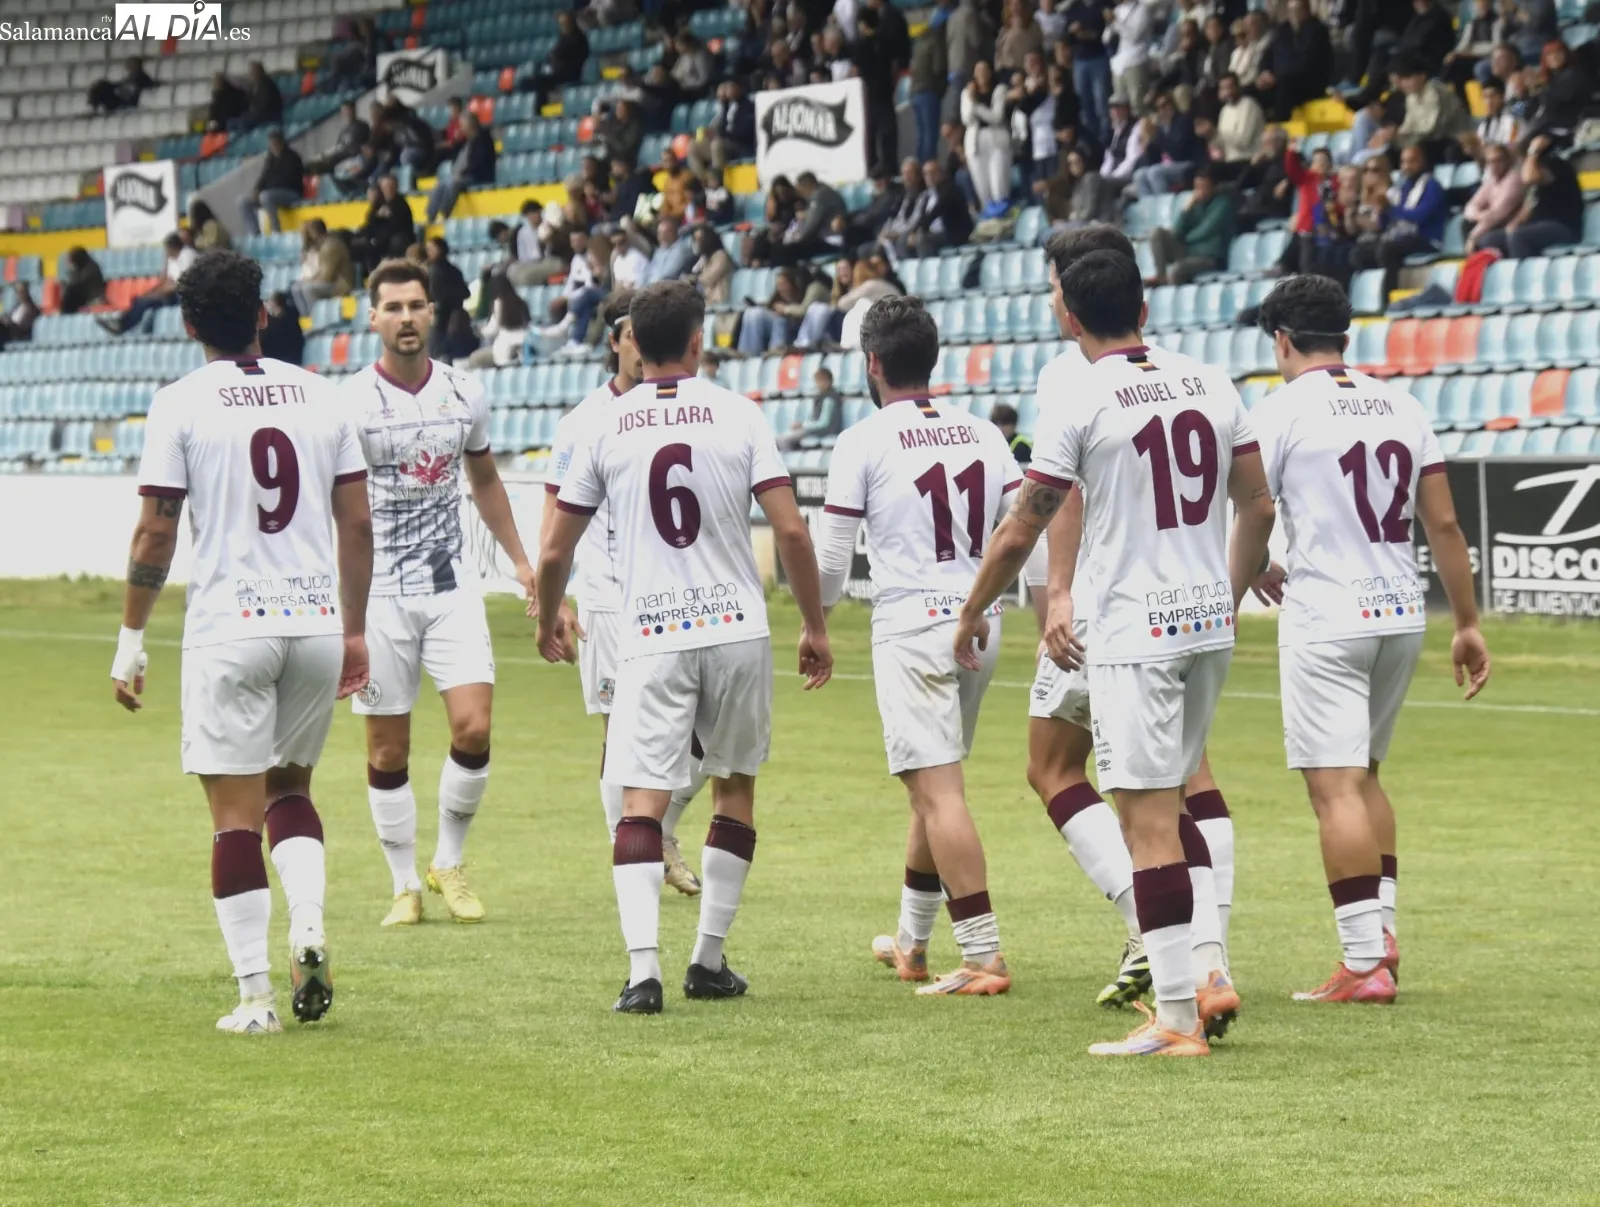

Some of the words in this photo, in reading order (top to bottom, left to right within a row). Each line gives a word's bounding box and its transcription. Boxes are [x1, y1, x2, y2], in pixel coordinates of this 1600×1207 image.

[219, 385, 306, 407] SERVETTI
[1115, 382, 1177, 409] MIGUEL
[617, 408, 658, 434] JOSE
[664, 406, 714, 426] LARA
[898, 425, 980, 450] MANCEBO
[250, 427, 300, 534] 9
[1132, 409, 1218, 531] 19
[649, 443, 701, 549] 6
[1338, 440, 1413, 543] 12
[914, 459, 984, 563] 11
[239, 593, 334, 608] EMPRESARIAL
[636, 586, 676, 610] nani
[684, 582, 738, 606] grupo
[1146, 583, 1188, 607] nani
[639, 600, 743, 626] EMPRESARIAL
